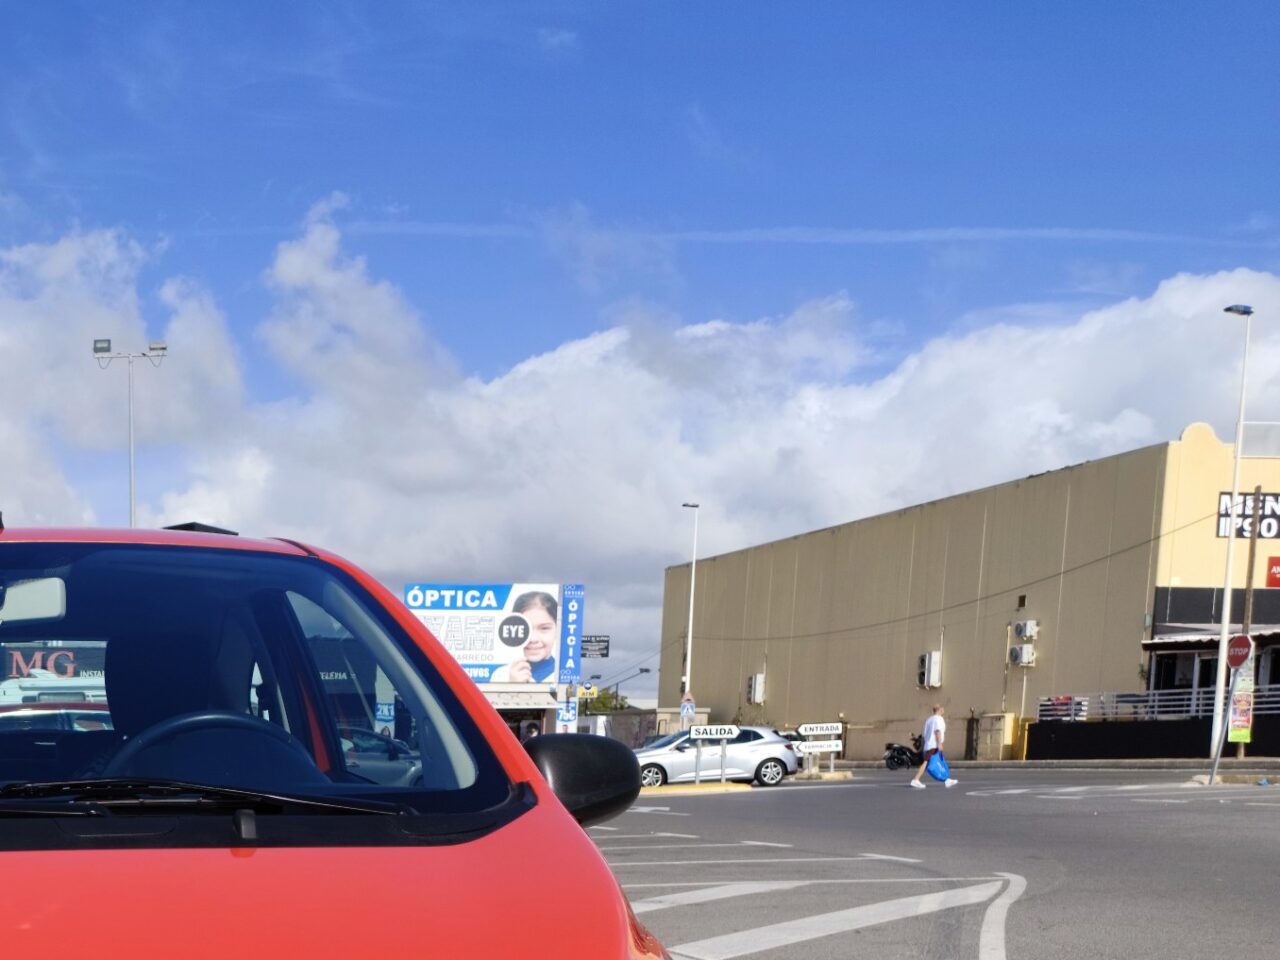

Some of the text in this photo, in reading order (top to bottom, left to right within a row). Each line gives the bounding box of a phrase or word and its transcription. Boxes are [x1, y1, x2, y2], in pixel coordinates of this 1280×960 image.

[406, 586, 498, 608] ÓPTICA
[502, 625, 525, 638] EYE
[1229, 648, 1248, 656] STOP
[8, 650, 78, 678] MG
[694, 727, 734, 736] SALIDA
[804, 725, 840, 733] ENTRADA
